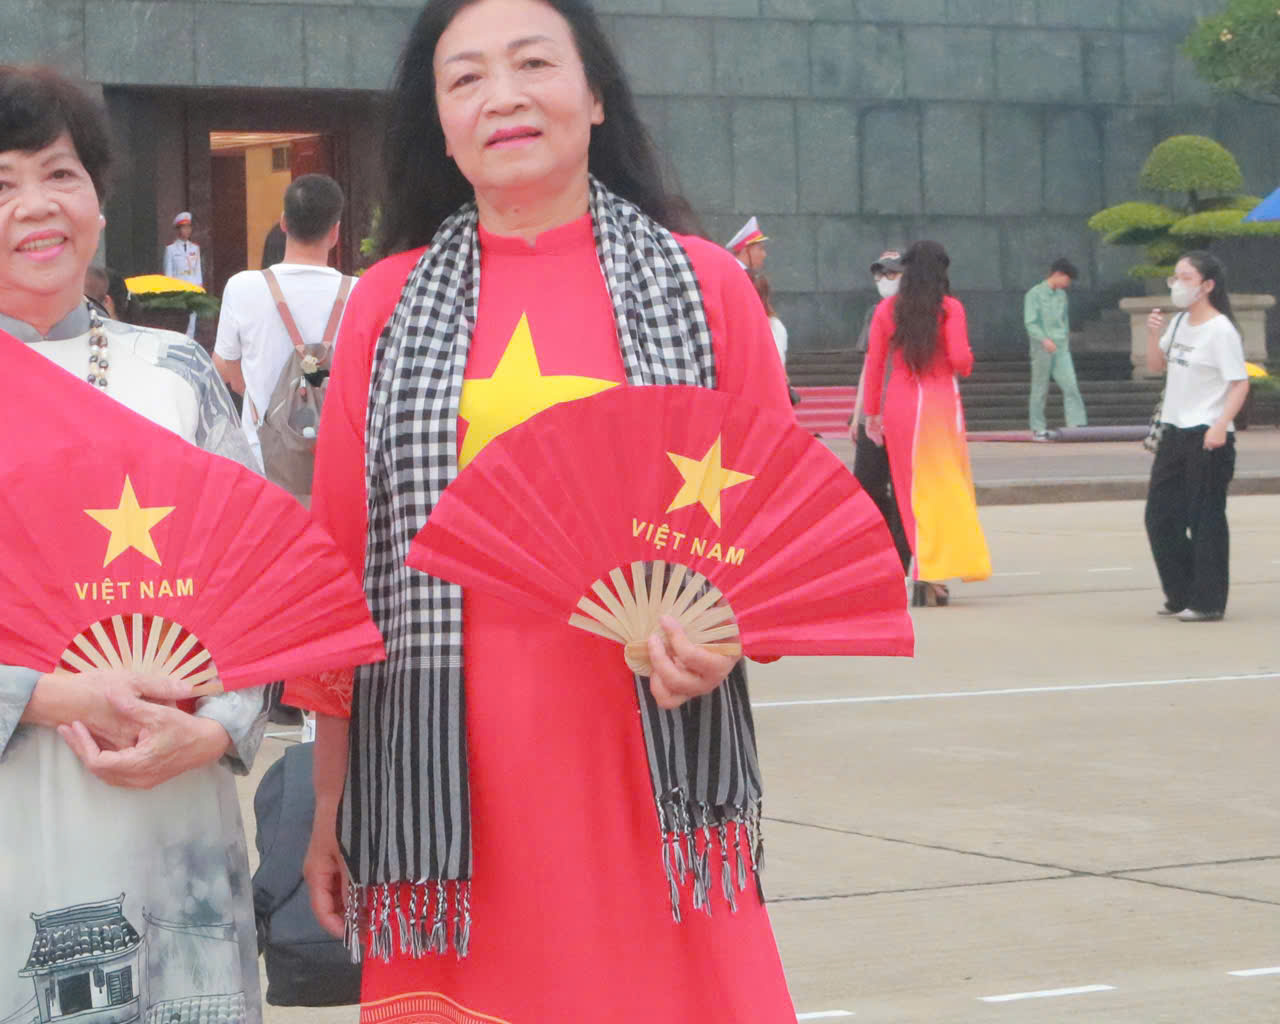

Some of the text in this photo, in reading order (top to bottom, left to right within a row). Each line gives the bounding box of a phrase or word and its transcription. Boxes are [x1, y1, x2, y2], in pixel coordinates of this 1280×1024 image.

[631, 517, 745, 566] VIỆT NAM
[74, 577, 193, 605] VIỆT NAM
